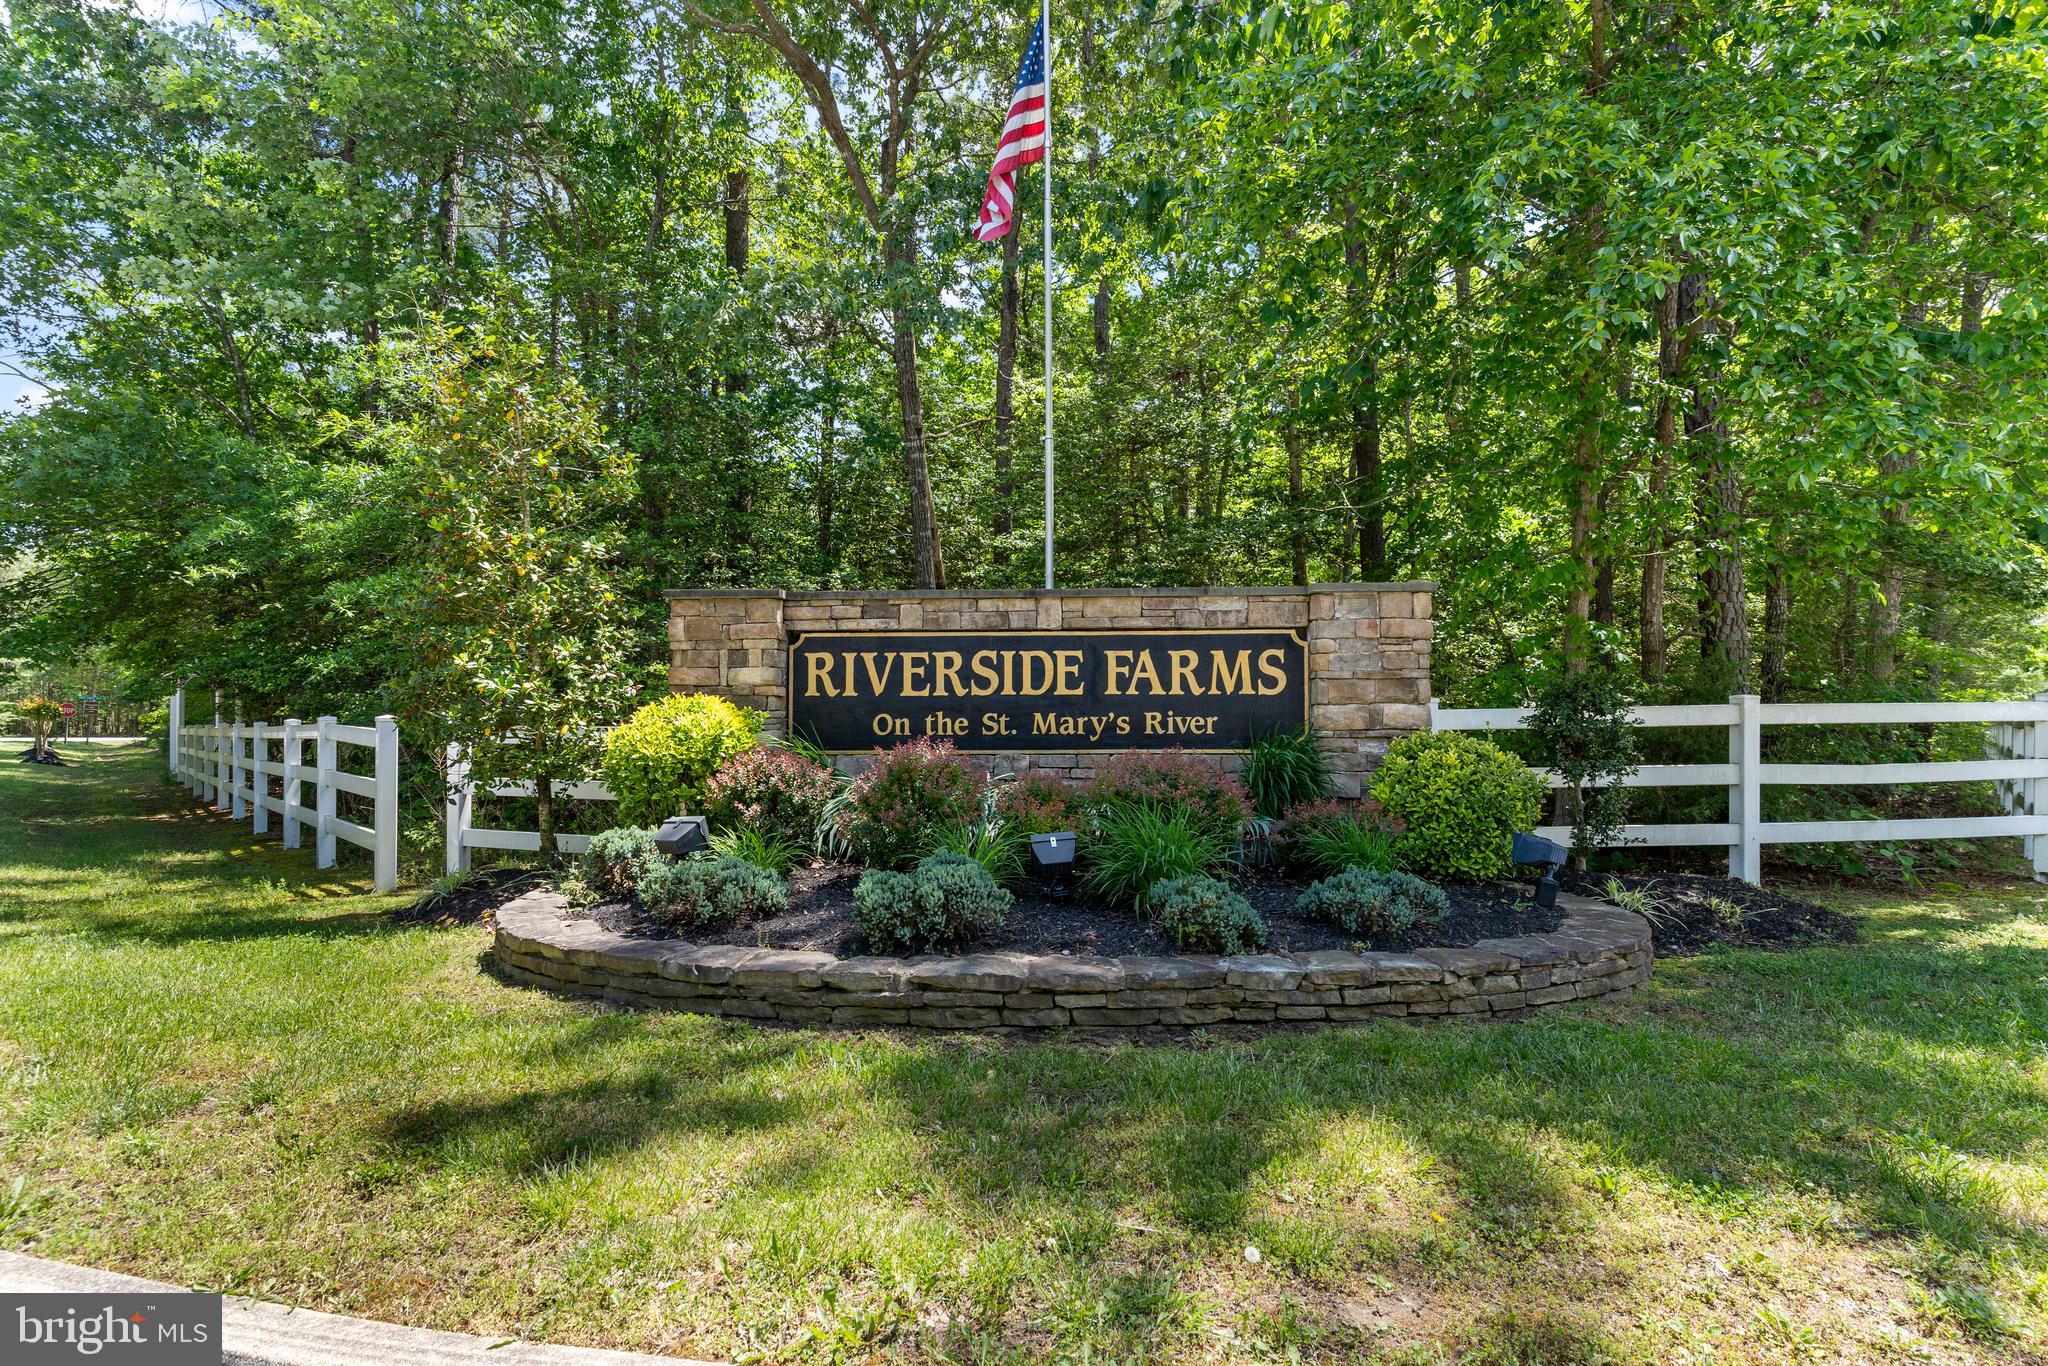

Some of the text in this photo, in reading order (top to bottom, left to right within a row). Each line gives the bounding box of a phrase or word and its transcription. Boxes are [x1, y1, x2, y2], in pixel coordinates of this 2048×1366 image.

[804, 648, 1288, 698] RIVERSIDE FARMS
[872, 710, 1218, 742] On the St. Mary's River
